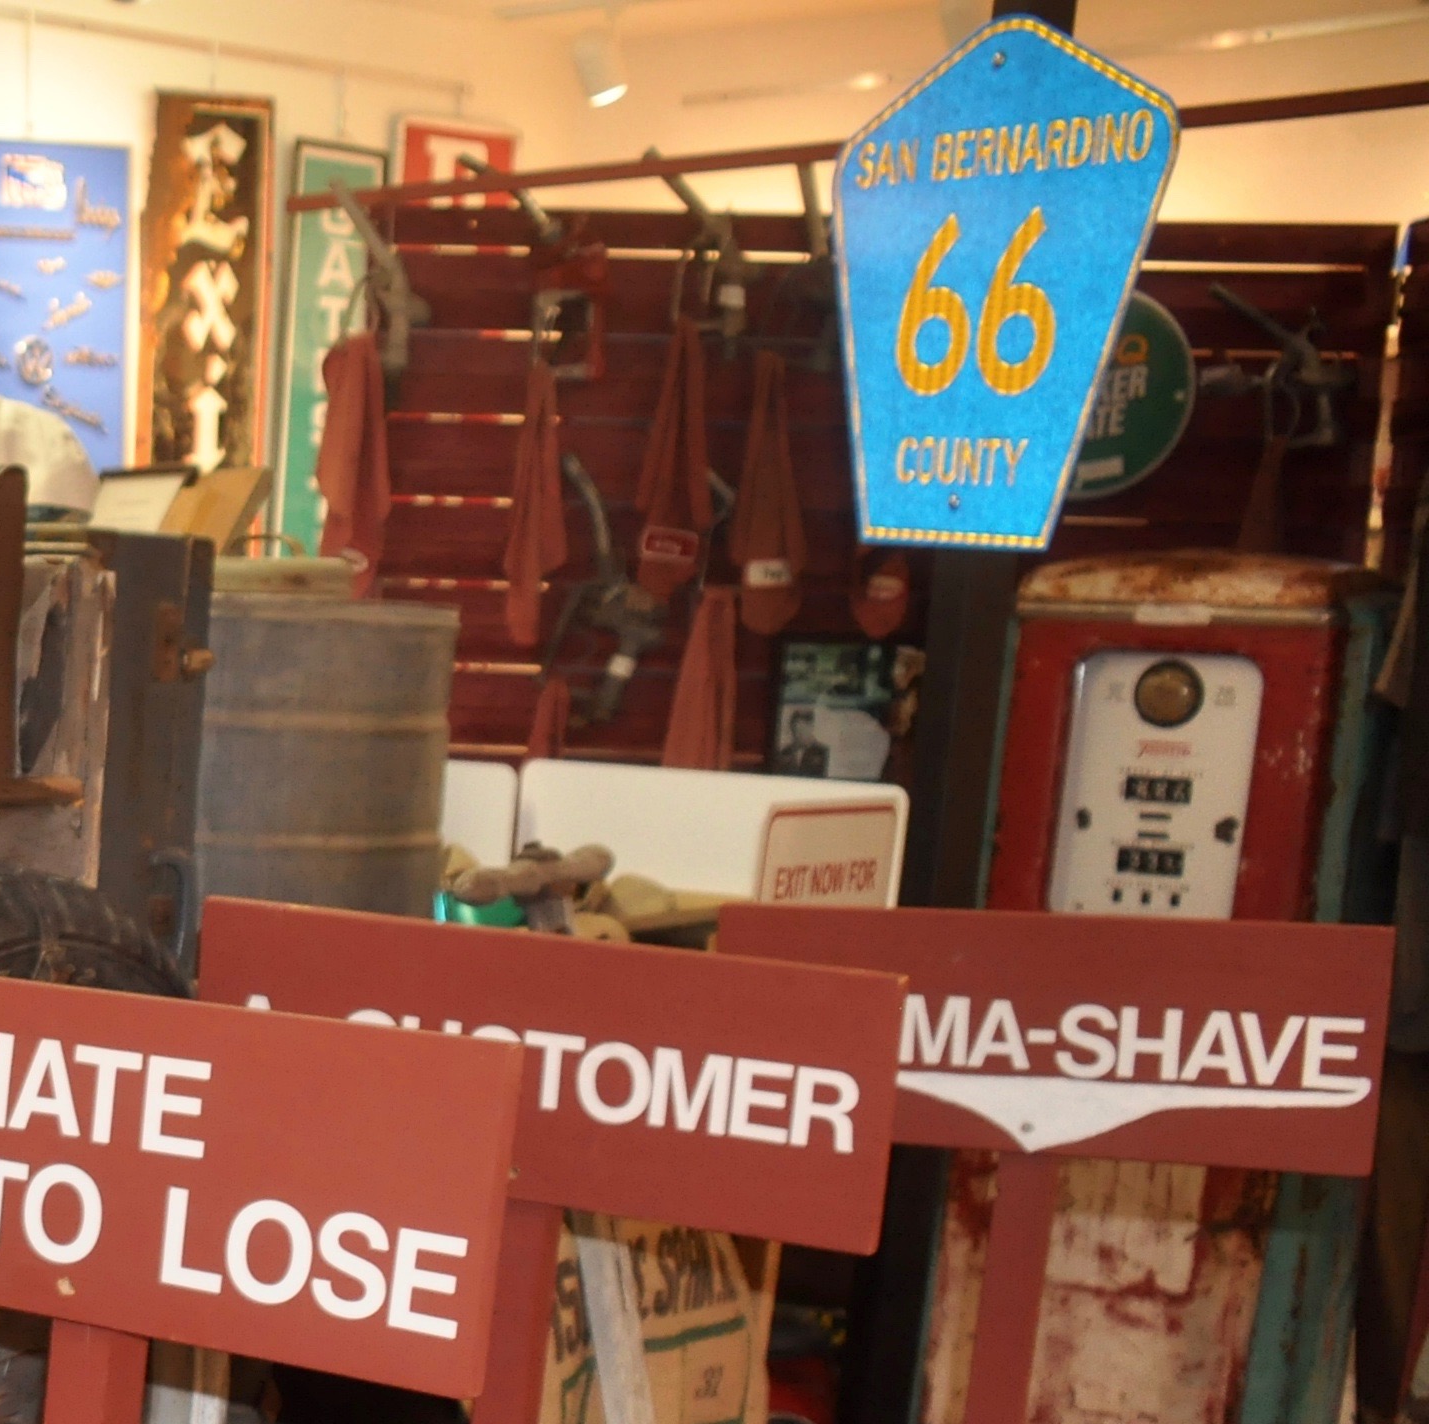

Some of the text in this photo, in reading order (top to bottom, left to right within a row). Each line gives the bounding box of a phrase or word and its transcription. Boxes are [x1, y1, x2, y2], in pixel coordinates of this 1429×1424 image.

[855, 109, 1155, 189] SAN BERNARDINO
[895, 206, 1056, 396] 66
[896, 436, 1029, 488] COUNTY
[775, 857, 878, 900] EXIT NOW FOR
[898, 993, 1371, 1091] MA-SHAVE
[158, 1187, 469, 1341] LOSE
